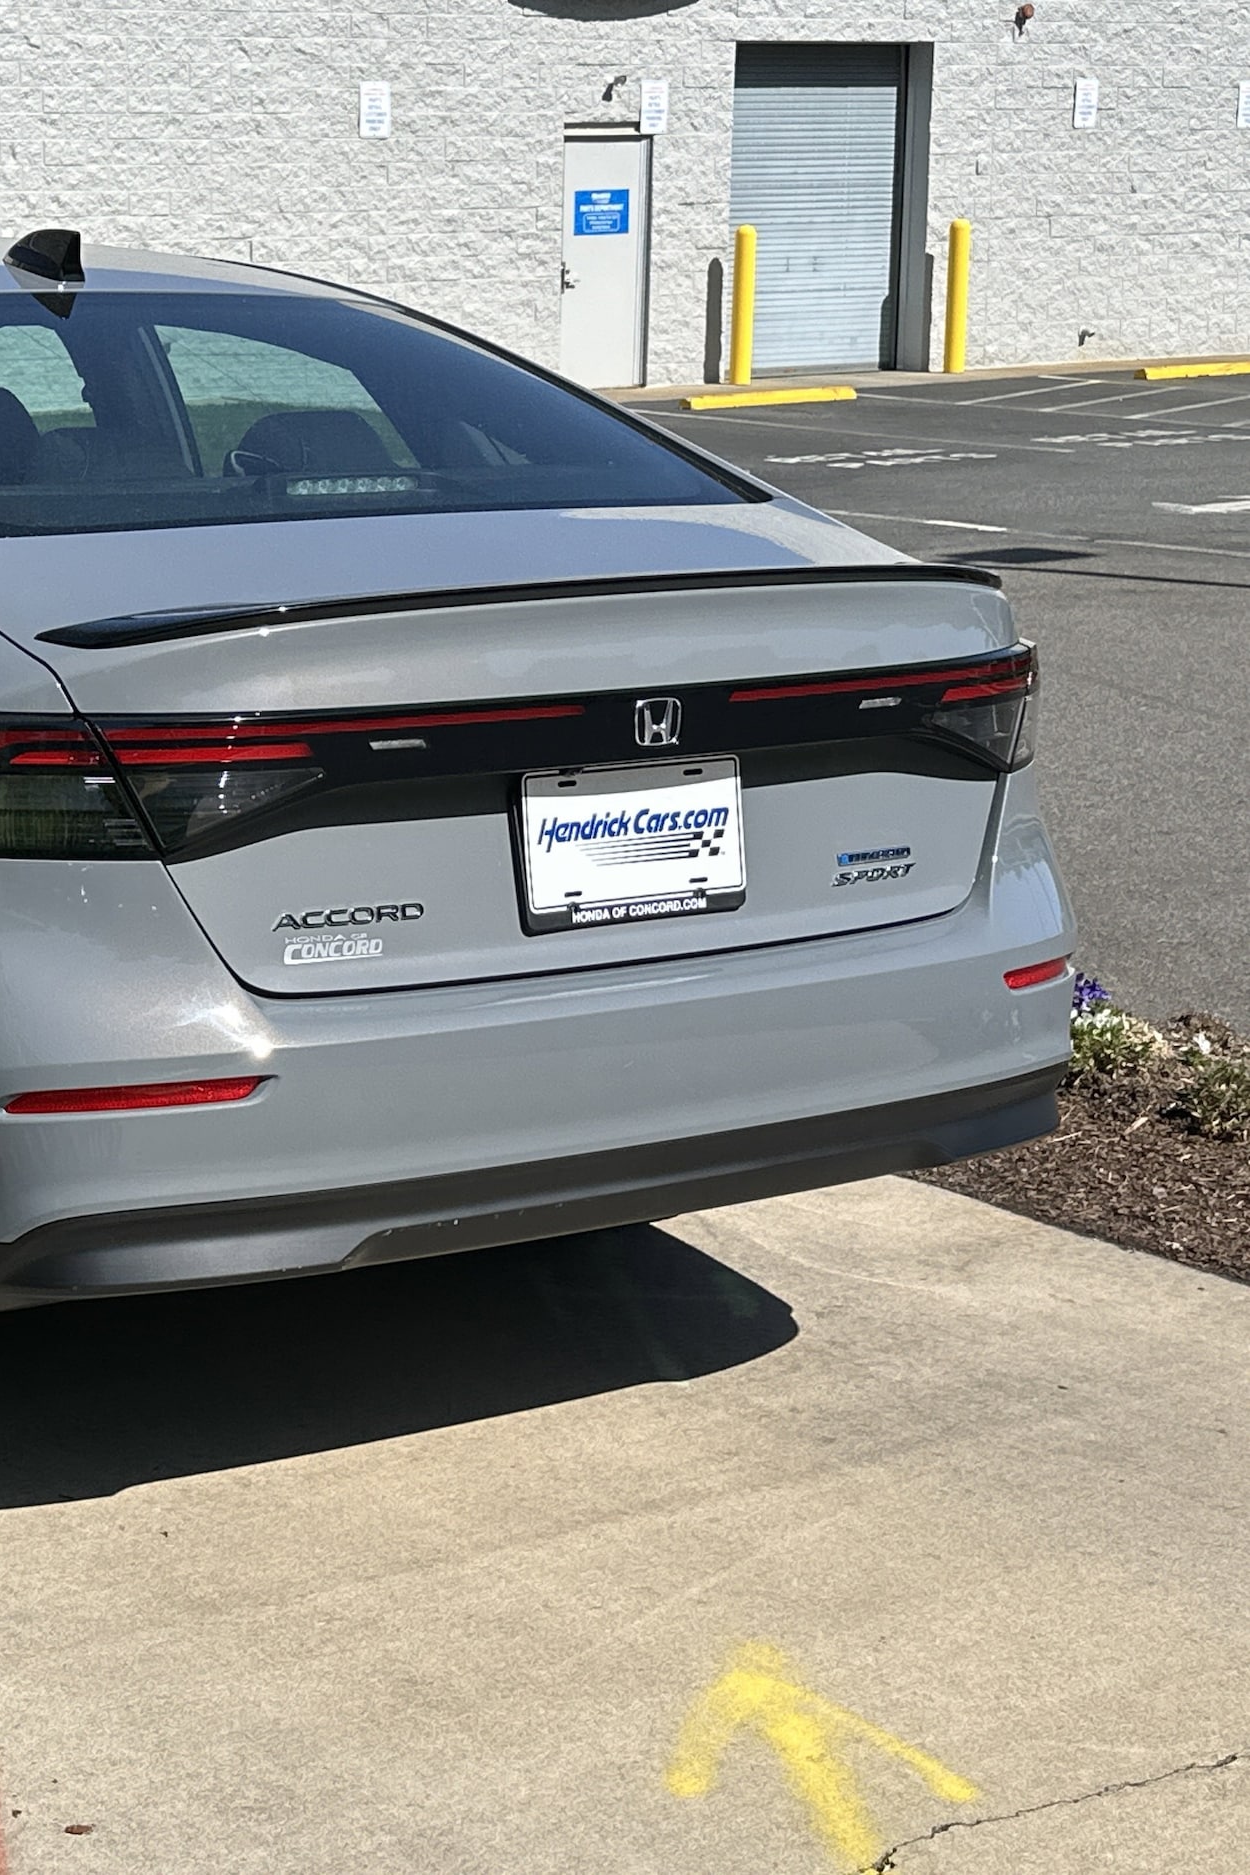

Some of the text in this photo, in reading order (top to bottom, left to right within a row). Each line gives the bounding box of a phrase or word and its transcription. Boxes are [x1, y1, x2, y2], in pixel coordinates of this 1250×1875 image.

[831, 862, 916, 887] SPORT
[271, 902, 424, 932] ACCORD
[572, 897, 707, 923] HONDA OF CONCORD.COM
[283, 938, 383, 965] CONCORD
[284, 934, 346, 944] HONDA
